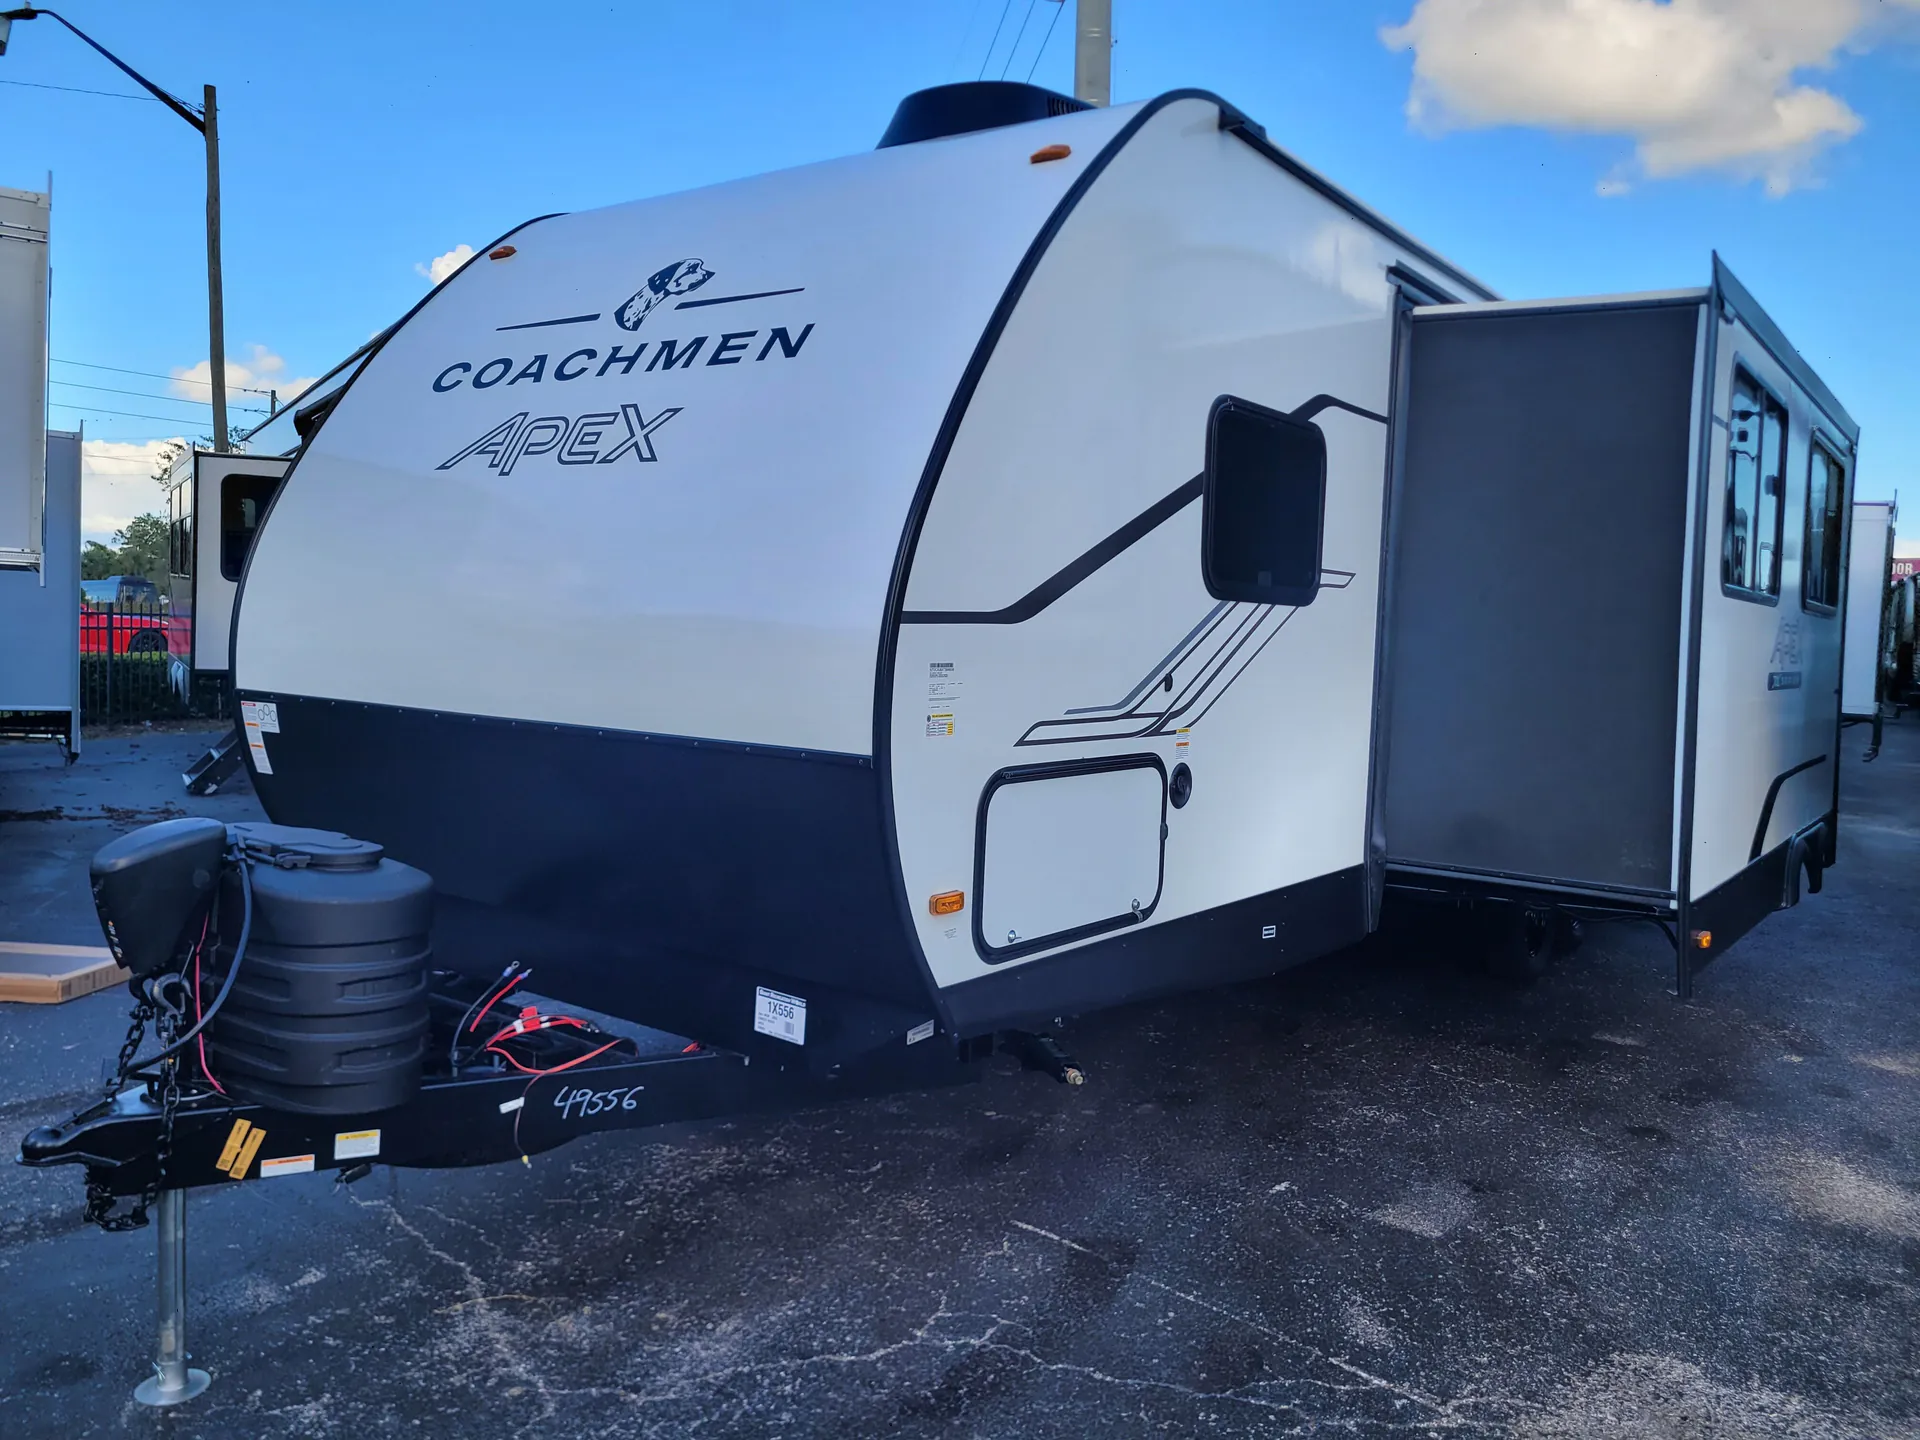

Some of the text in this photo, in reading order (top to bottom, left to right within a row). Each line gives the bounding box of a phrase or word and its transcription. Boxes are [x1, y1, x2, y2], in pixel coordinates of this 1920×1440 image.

[432, 323, 816, 393] COACHMEN
[435, 403, 684, 476] APEX
[767, 1001, 795, 1020] 1X556
[553, 1085, 645, 1120] 49556
